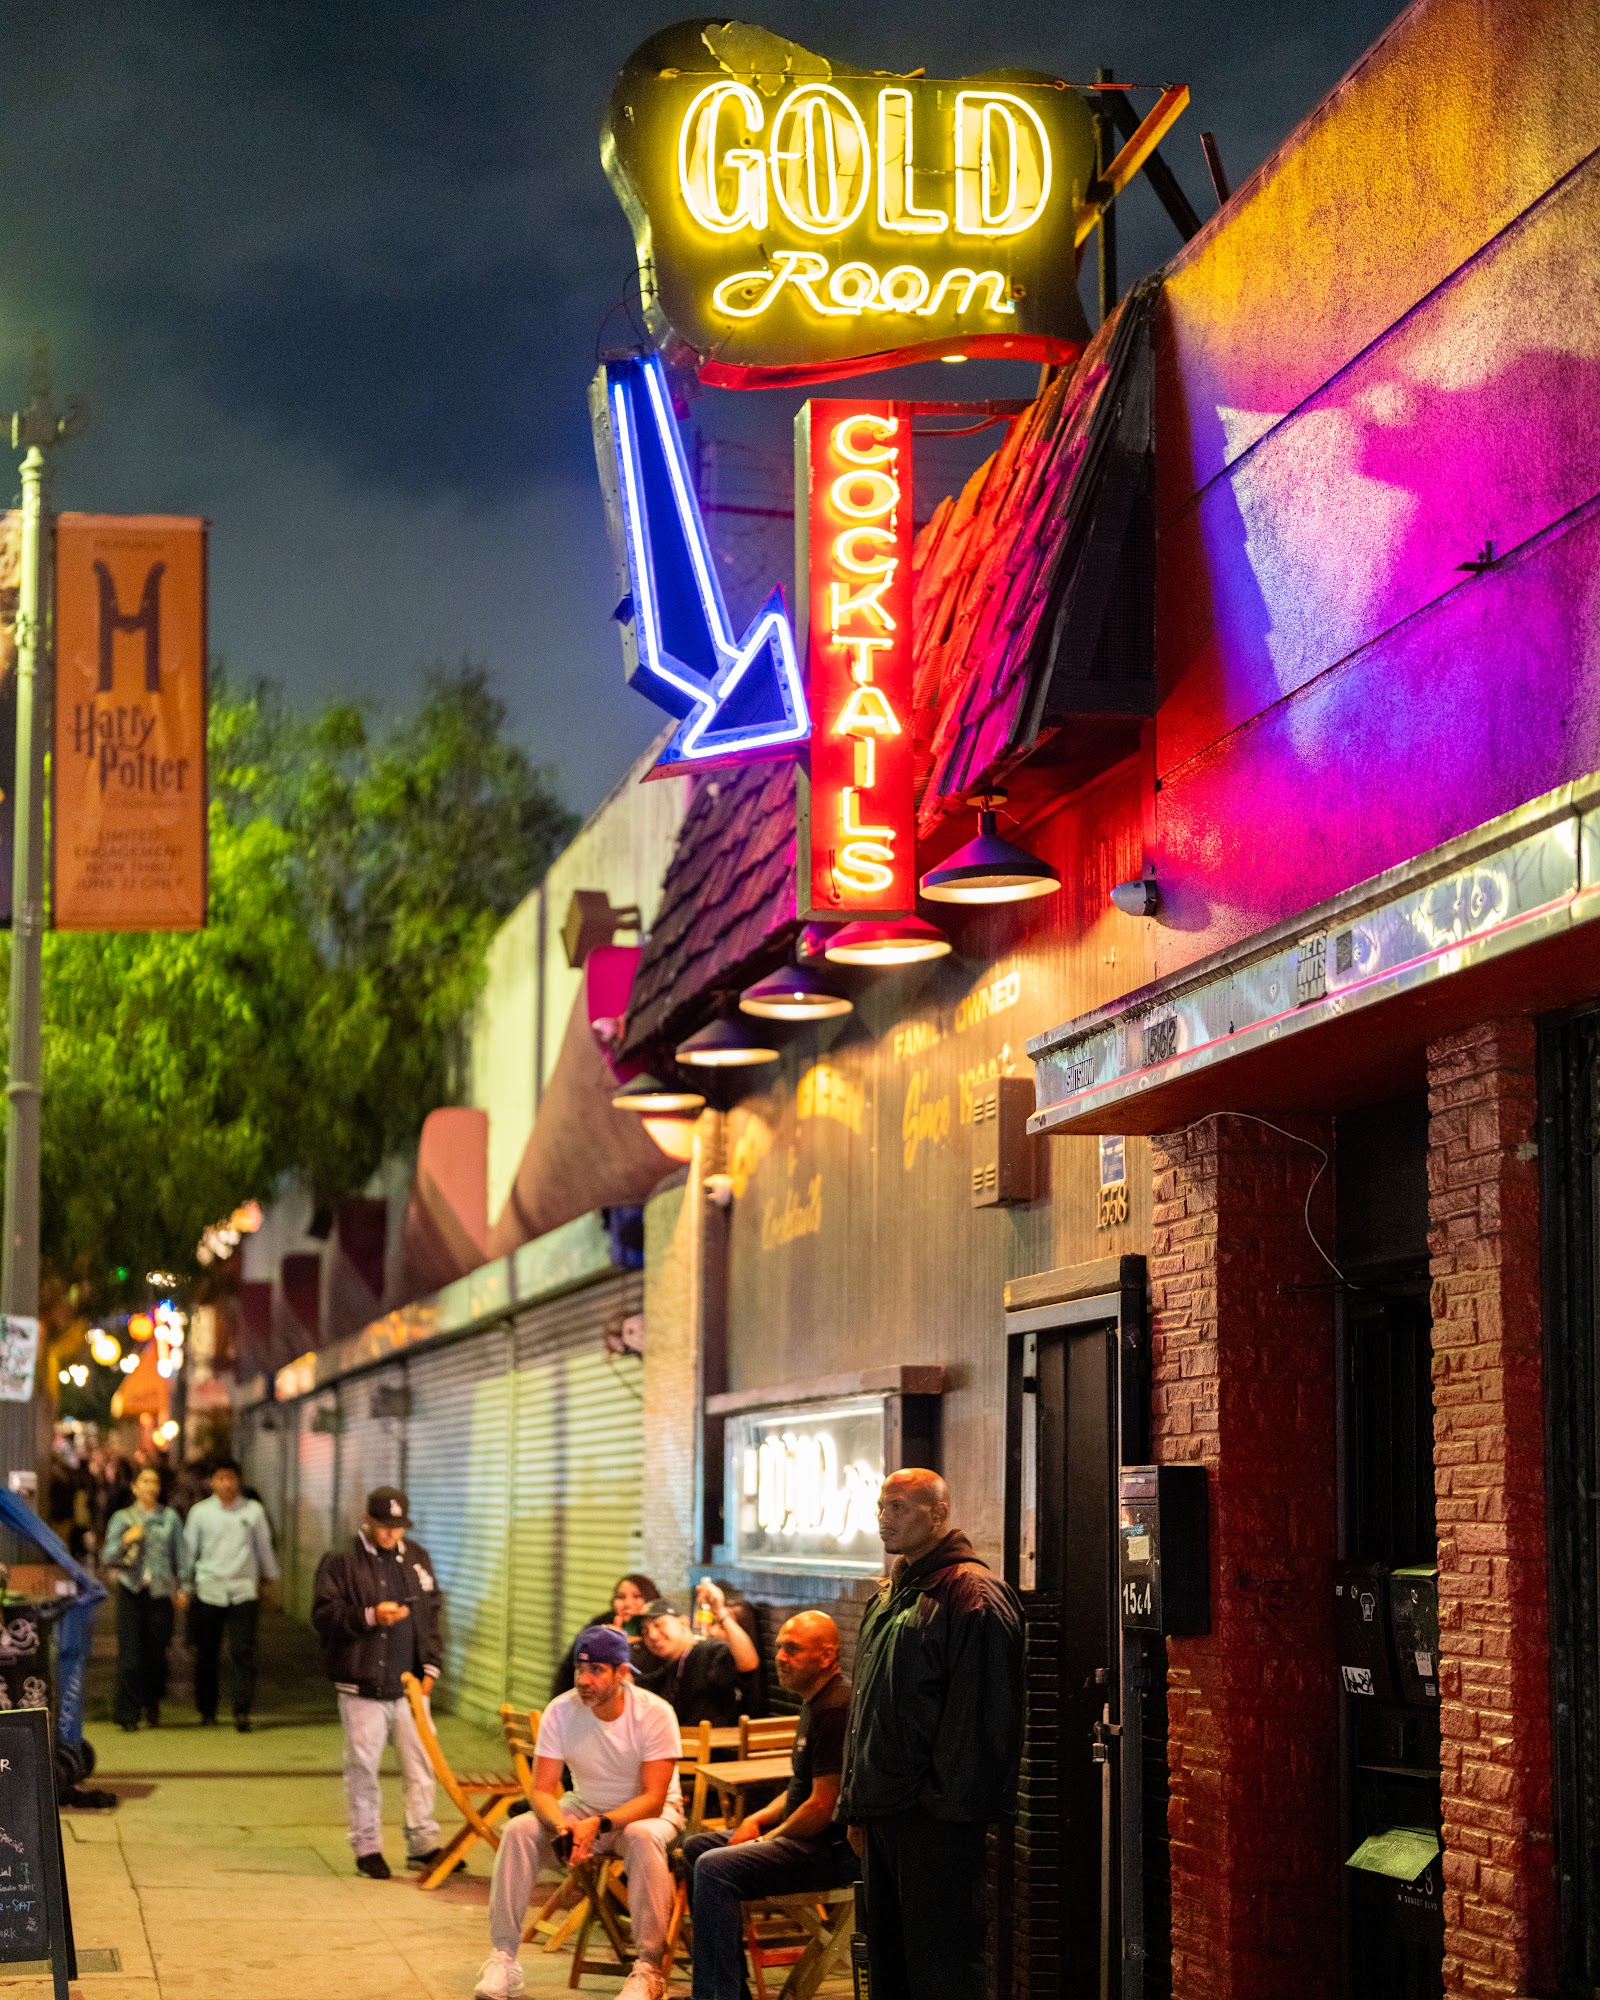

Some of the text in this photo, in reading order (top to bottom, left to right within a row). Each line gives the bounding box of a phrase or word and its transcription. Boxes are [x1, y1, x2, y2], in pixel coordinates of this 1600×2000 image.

[678, 80, 1053, 235] GOLD
[713, 250, 1015, 318] Room
[830, 413, 901, 893] COCKTAILS
[68, 702, 157, 758] Harry
[99, 742, 190, 796] Potter
[955, 971, 1020, 1034] OWNED
[1096, 1184, 1128, 1228] 1558
